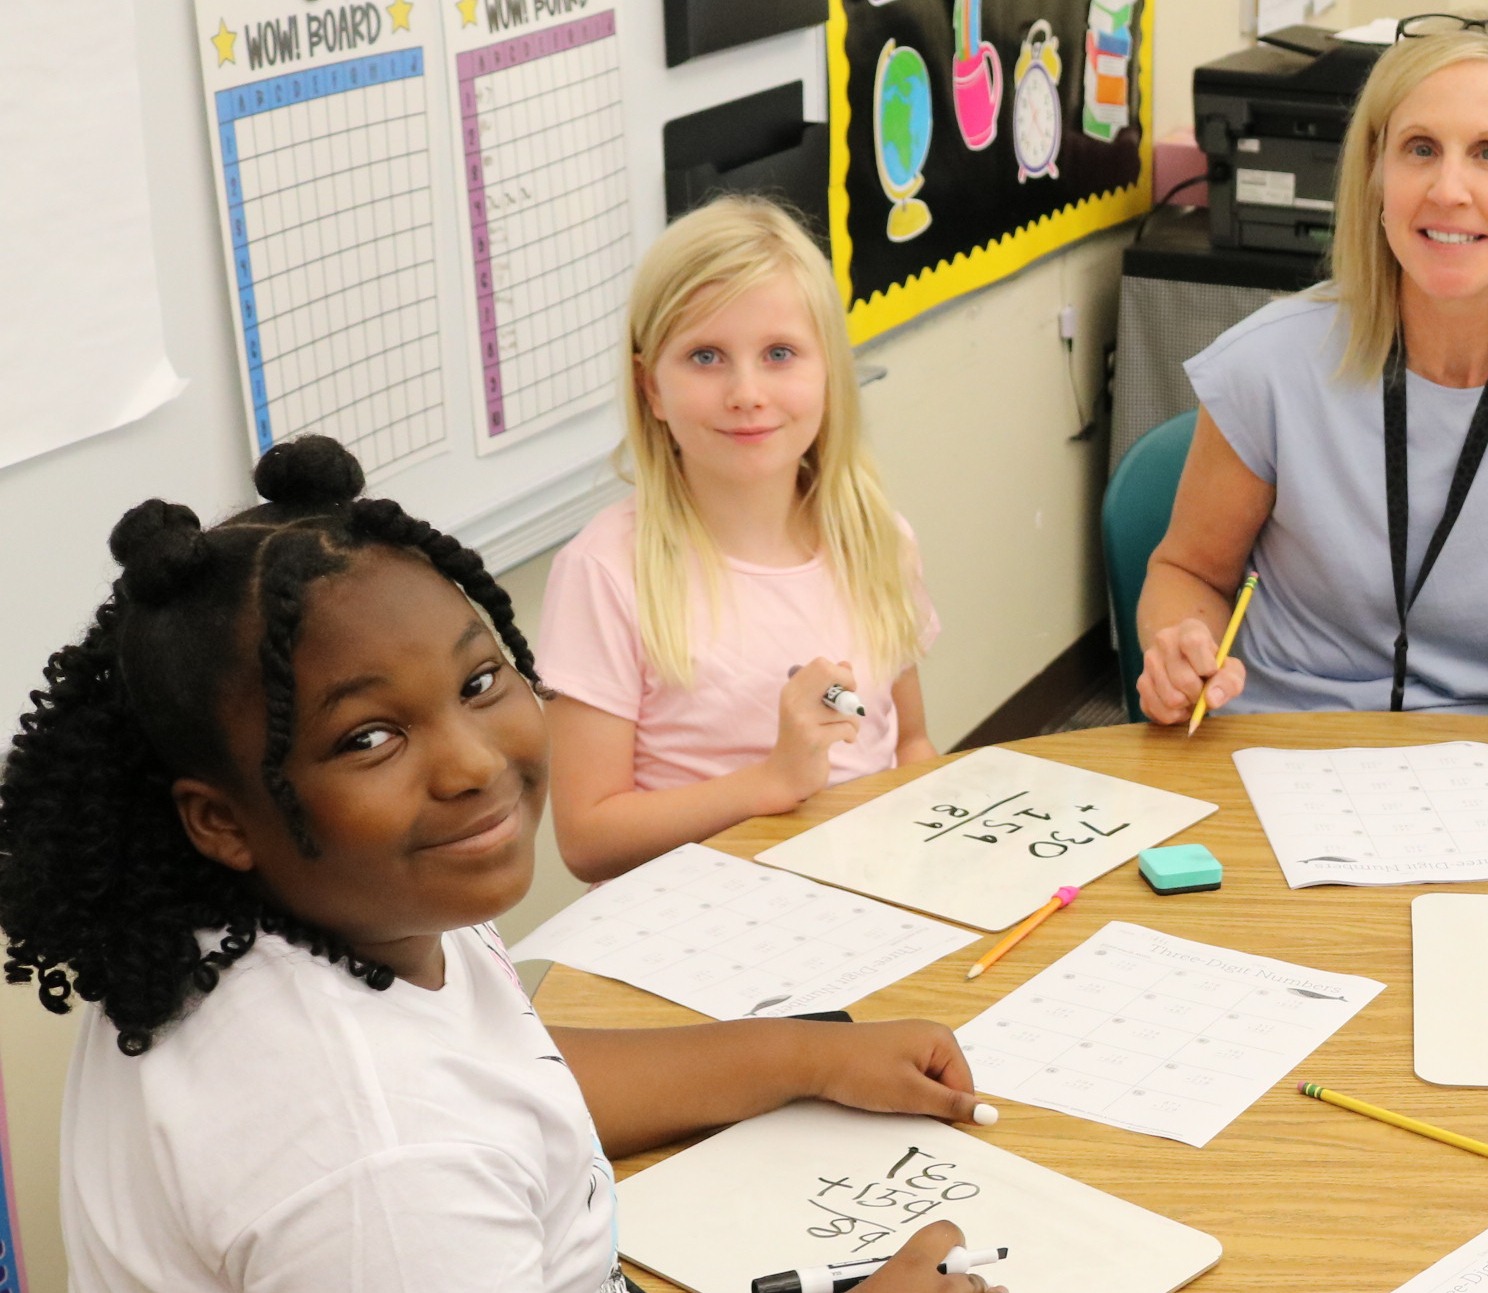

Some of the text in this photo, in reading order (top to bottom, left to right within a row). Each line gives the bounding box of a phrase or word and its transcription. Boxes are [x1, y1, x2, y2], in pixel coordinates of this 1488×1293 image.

[244, 2, 382, 71] WOW! BOARD
[1313, 861, 1400, 874] Numbers
[766, 943, 923, 1016] Three-Digit Numbers
[1149, 943, 1251, 976] Three-Digit
[1254, 966, 1343, 995] Numbers
